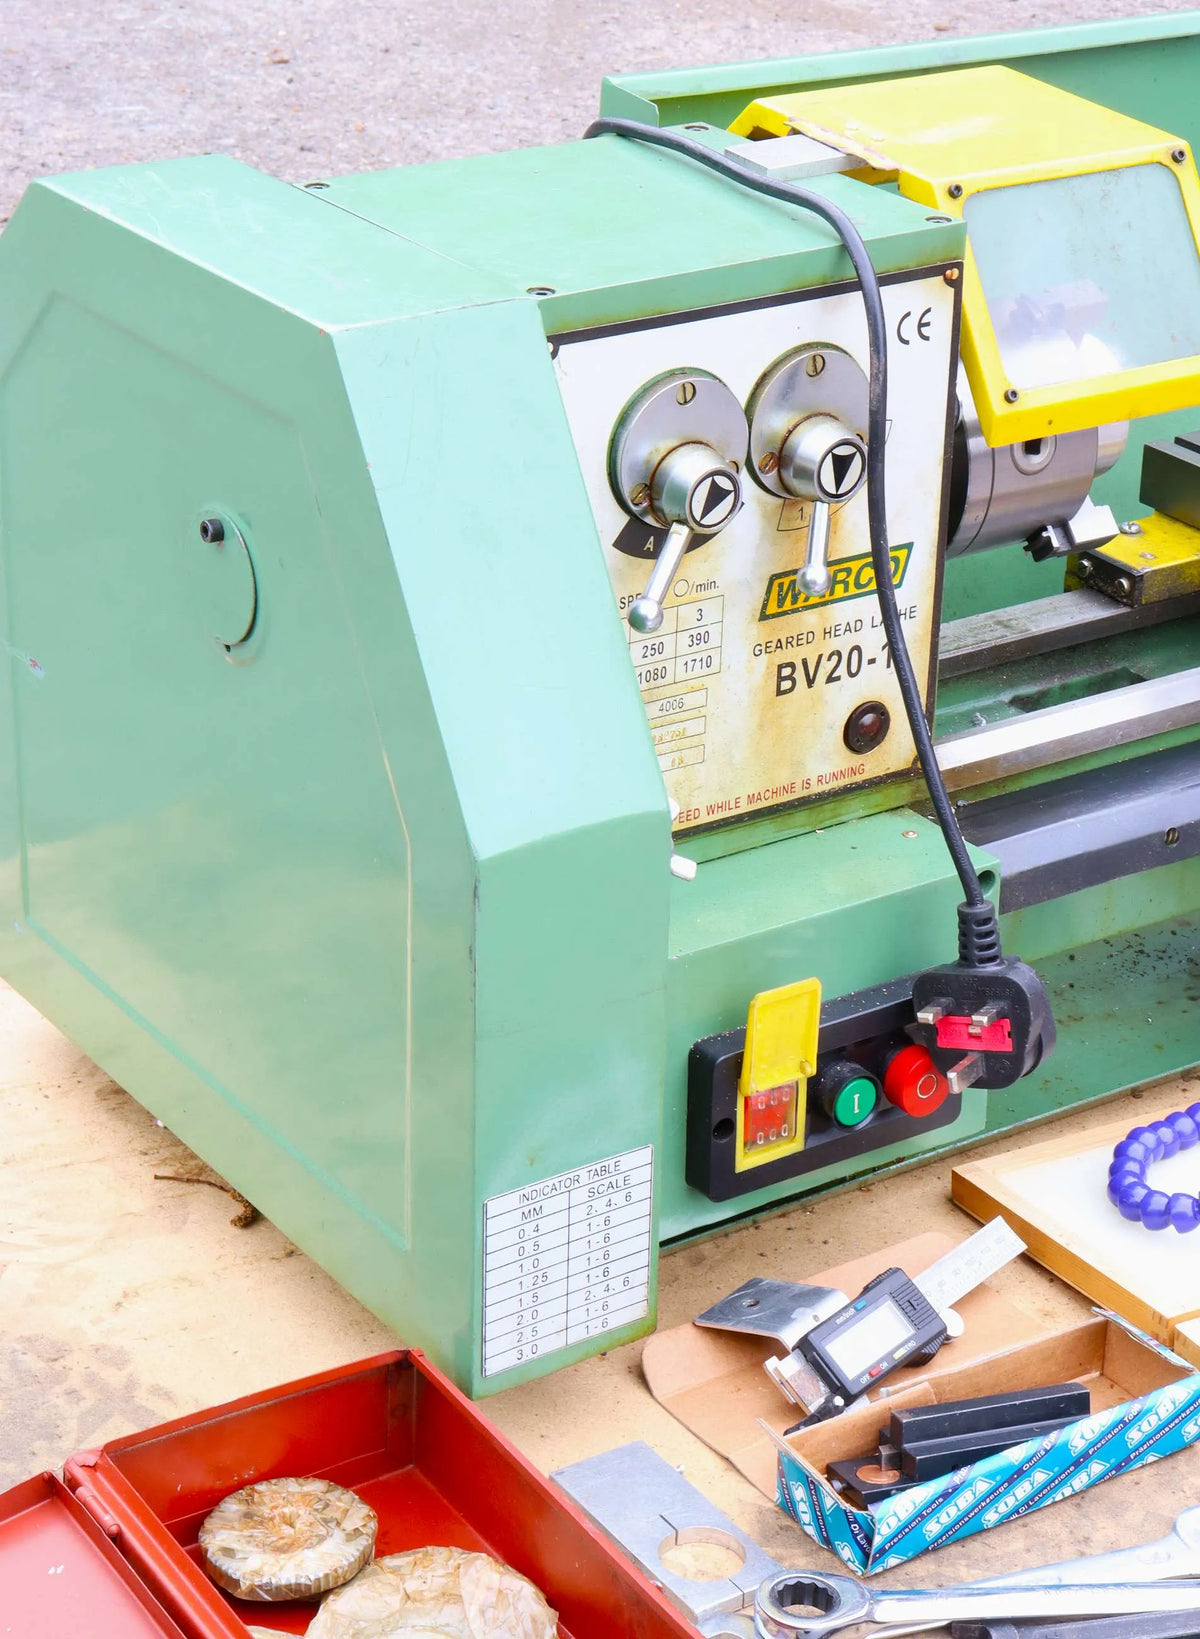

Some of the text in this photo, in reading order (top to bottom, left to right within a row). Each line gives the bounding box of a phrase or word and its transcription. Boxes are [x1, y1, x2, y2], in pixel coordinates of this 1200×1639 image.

[897, 307, 932, 345] CE
[798, 506, 804, 521] 1
[643, 536, 654, 552] A
[696, 608, 703, 621] 3
[642, 631, 710, 659] 250 390
[753, 605, 917, 657] GEARED HEAD LHE
[637, 655, 712, 684] 1080 1710
[659, 697, 685, 713] 4006
[706, 796, 741, 816] WHILE
[746, 782, 796, 806] MACHINE
[801, 778, 811, 791] IS
[817, 763, 865, 787] RUNNING
[519, 1160, 621, 1203] INDICATOR TABLE
[521, 1175, 631, 1221] MM SCALE
[860, 1374, 871, 1385] OFF
[1088, 1423, 1123, 1455] Precision
[1022, 1449, 1047, 1471] Outils
[923, 1476, 996, 1542] SOBA
[981, 1467, 1054, 1529] SOBA
[884, 1496, 944, 1550] Precision Tools
